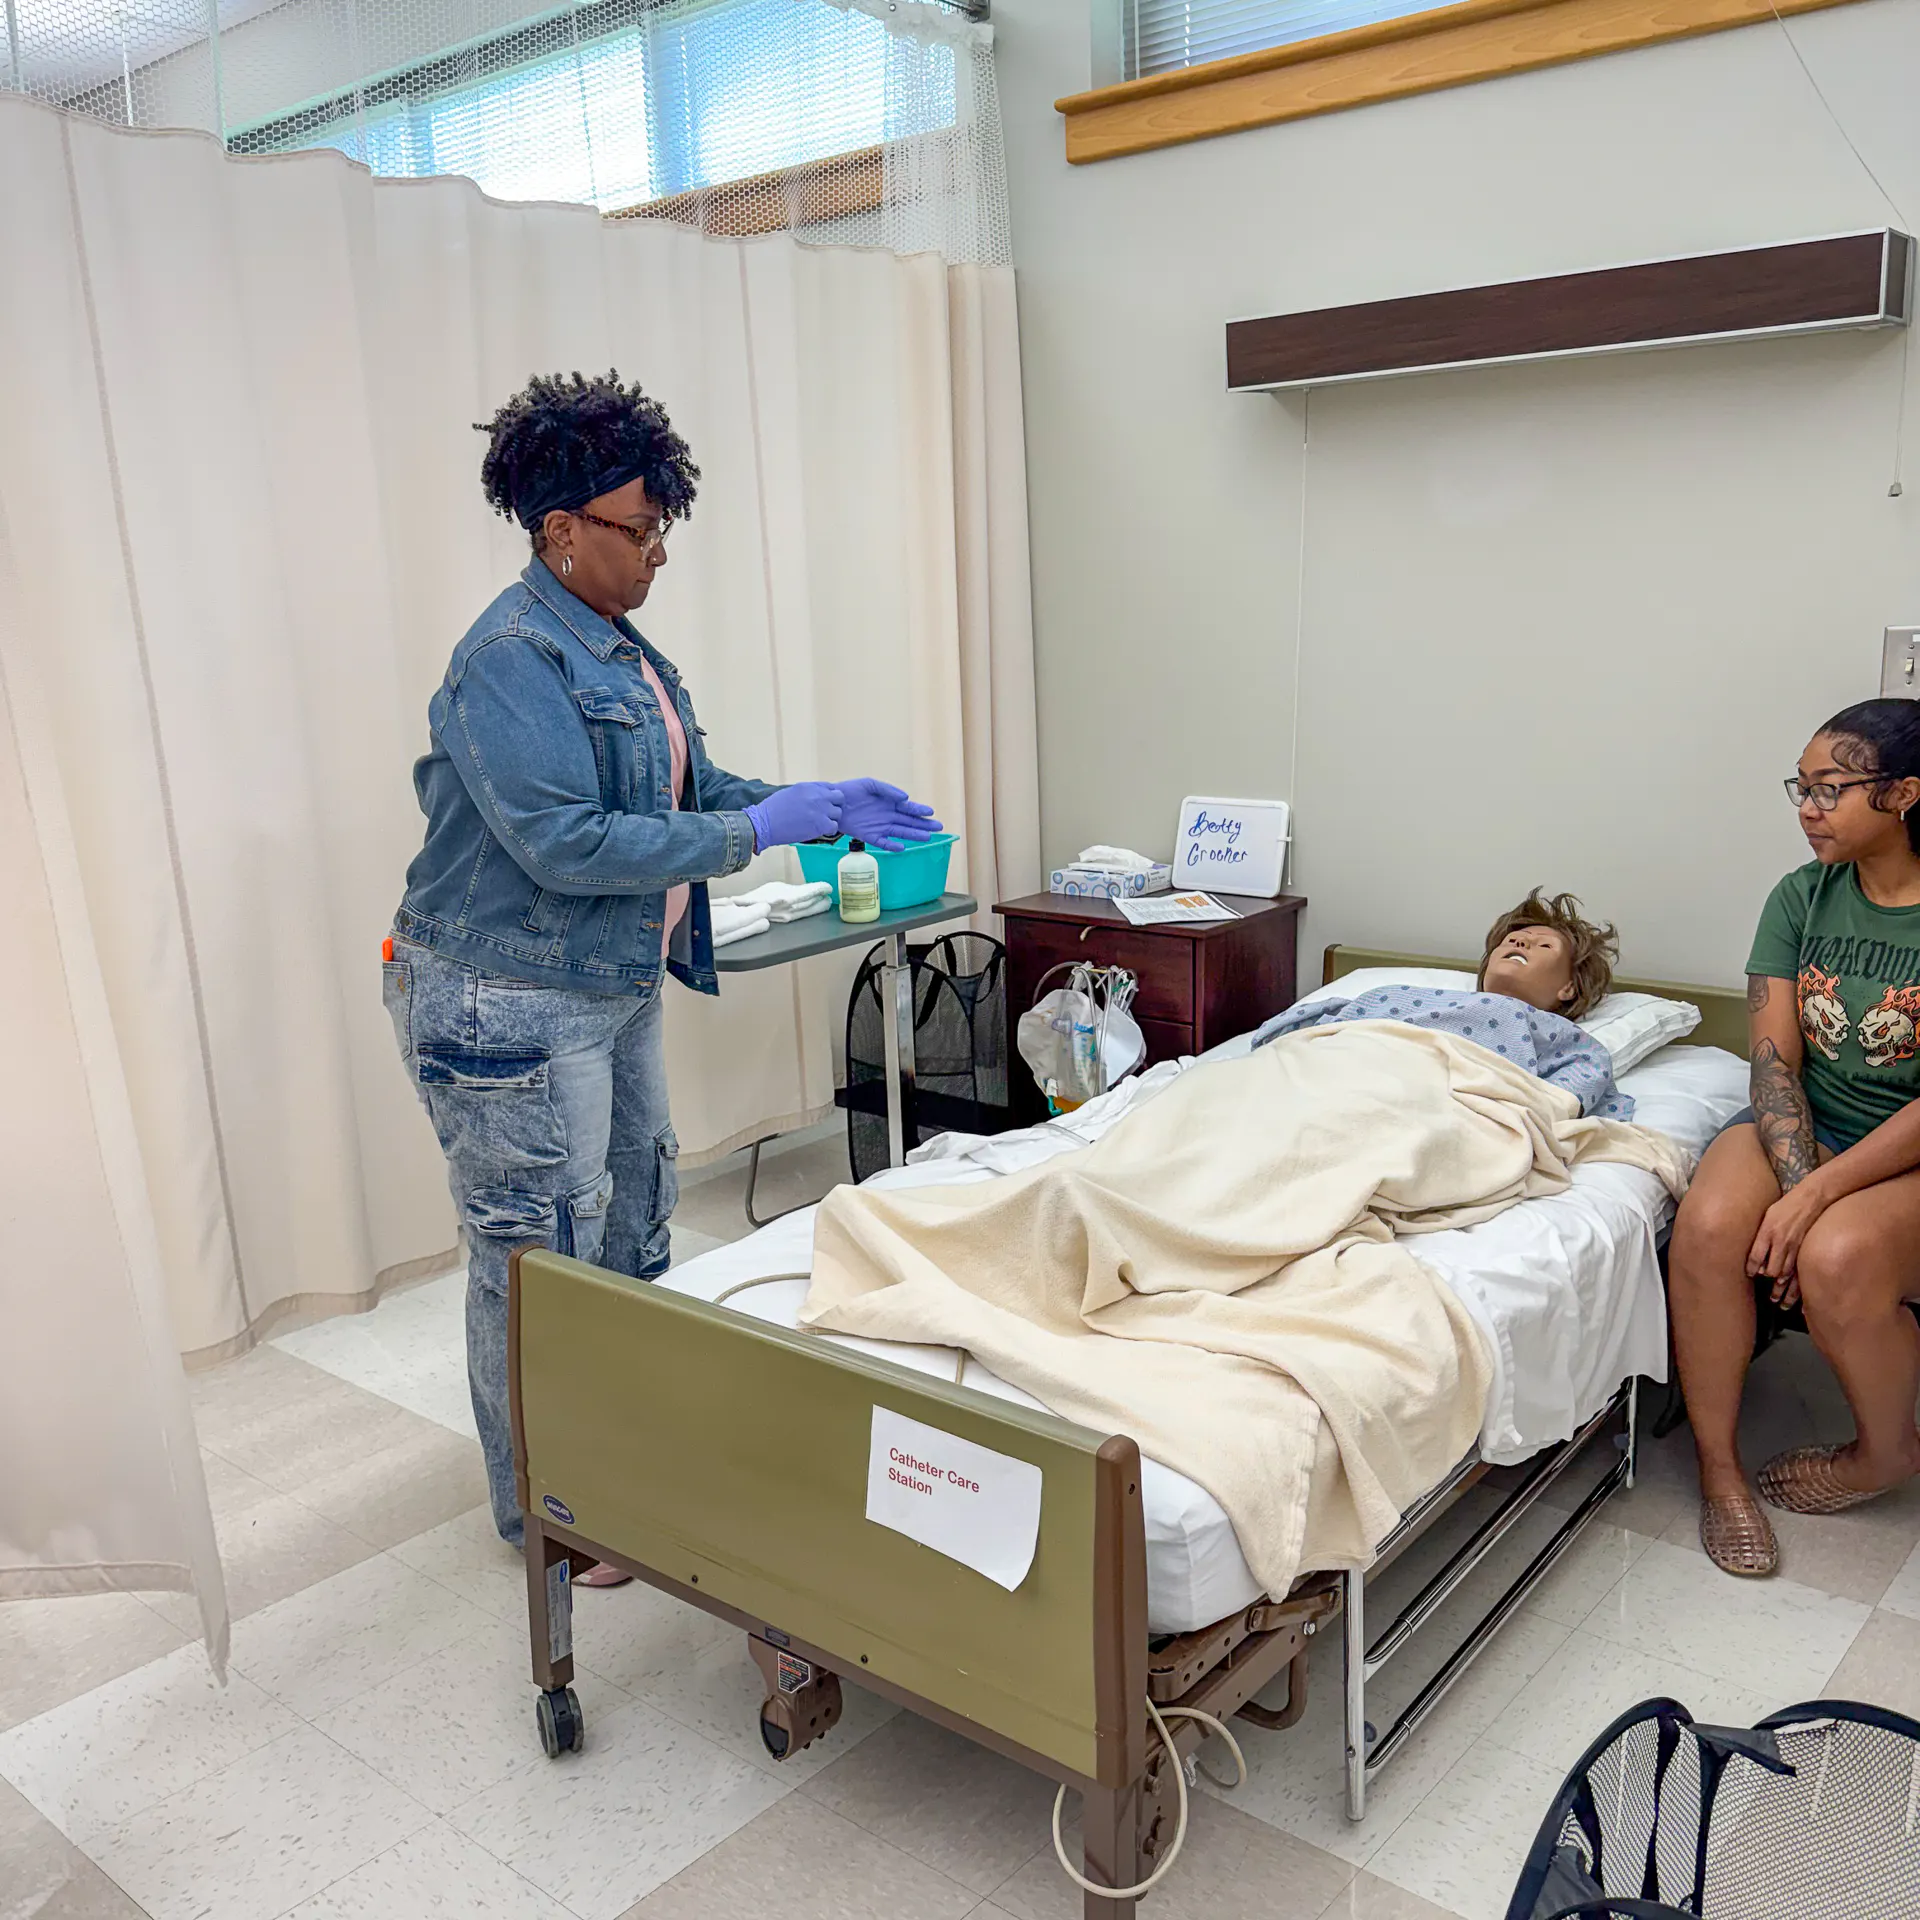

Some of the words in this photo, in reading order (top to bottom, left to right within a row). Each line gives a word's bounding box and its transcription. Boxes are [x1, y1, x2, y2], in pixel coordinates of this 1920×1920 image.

[1188, 811, 1242, 844] Betty
[888, 1467, 932, 1496] Station
[889, 1447, 944, 1479] Catheter
[947, 1470, 980, 1492] Care
